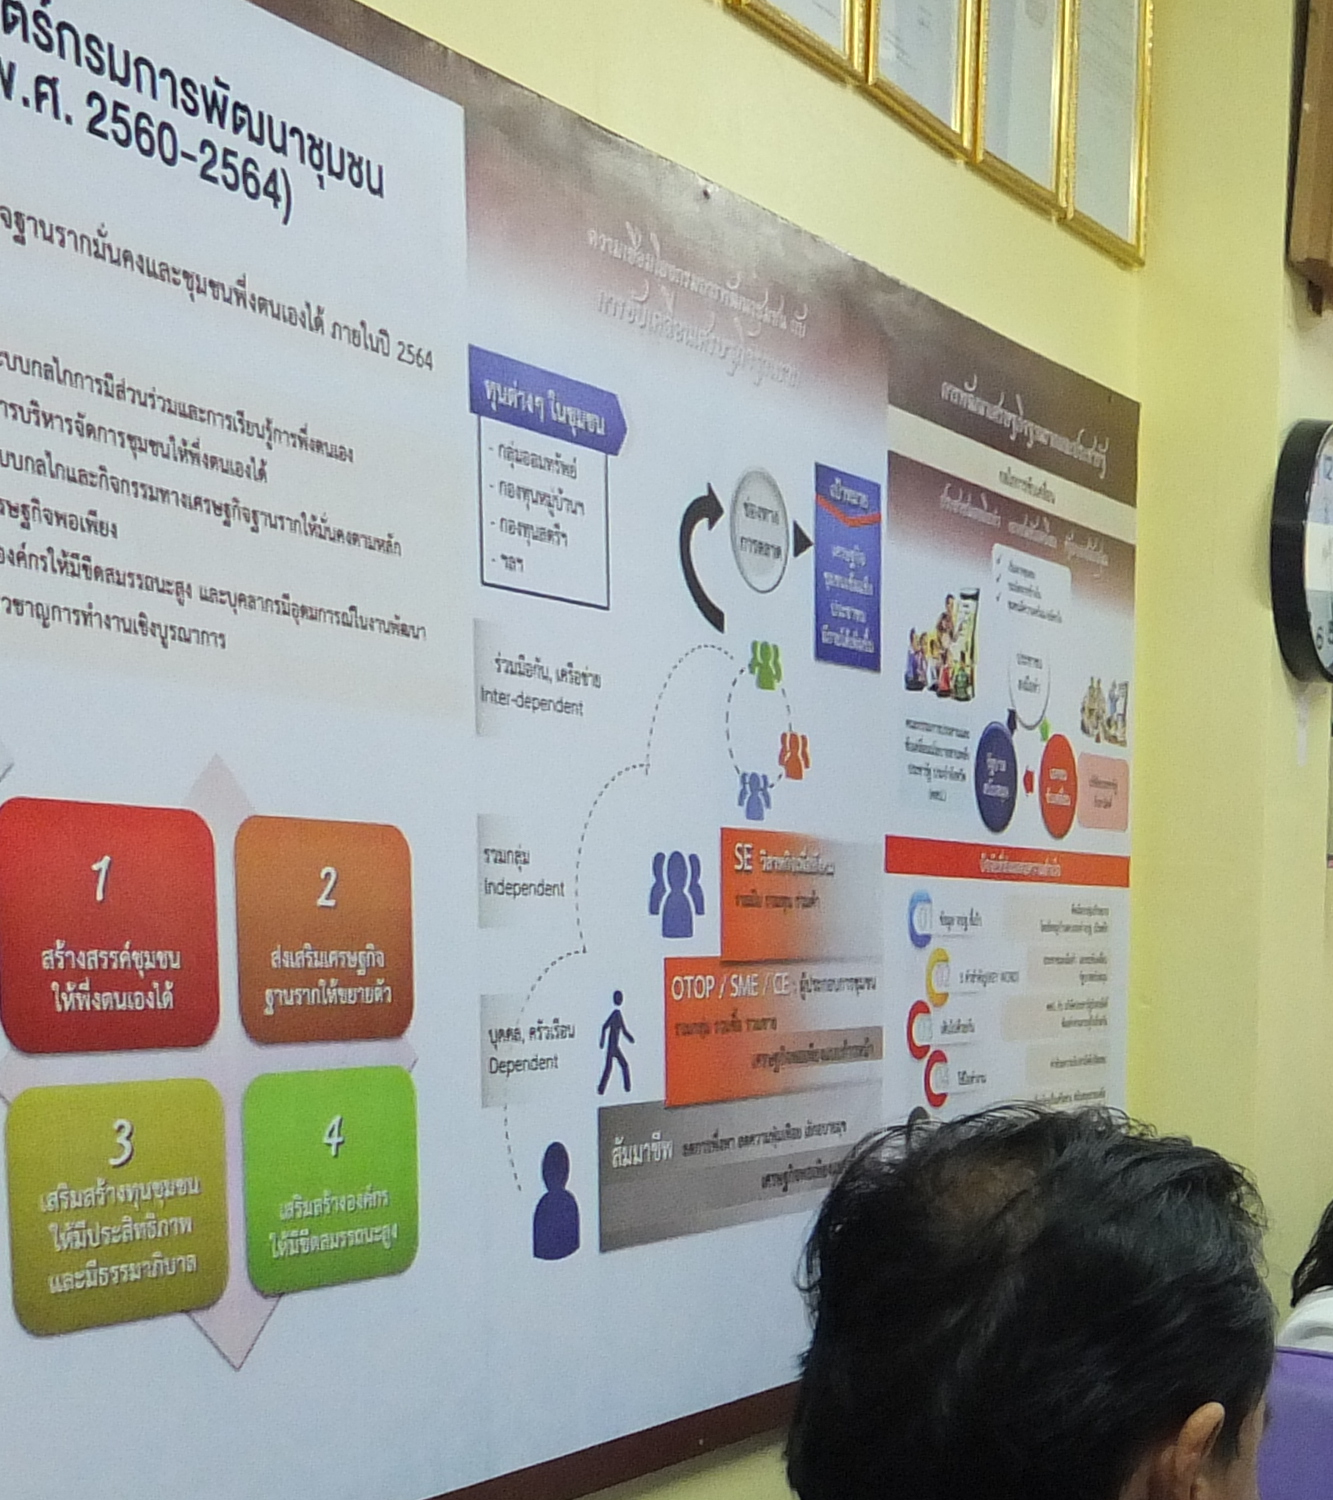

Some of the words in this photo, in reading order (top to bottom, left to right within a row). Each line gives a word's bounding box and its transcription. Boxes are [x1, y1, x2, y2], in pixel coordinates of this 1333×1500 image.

[86, 90, 293, 226] 2560-2564)
[331, 320, 391, 358] ภายในปี
[397, 340, 434, 371] 2564
[480, 685, 585, 717] Inter-dependent
[734, 842, 754, 873] SE
[91, 855, 112, 902] 1
[316, 866, 339, 908] 2
[484, 877, 566, 899] Independent
[41, 940, 182, 979] สร้างสรรค์ชุมชน
[671, 975, 715, 1001] OTOP
[730, 974, 760, 998] SME
[488, 1053, 559, 1079] Dependent
[108, 1118, 135, 1168] 3
[322, 1115, 345, 1158] 4
